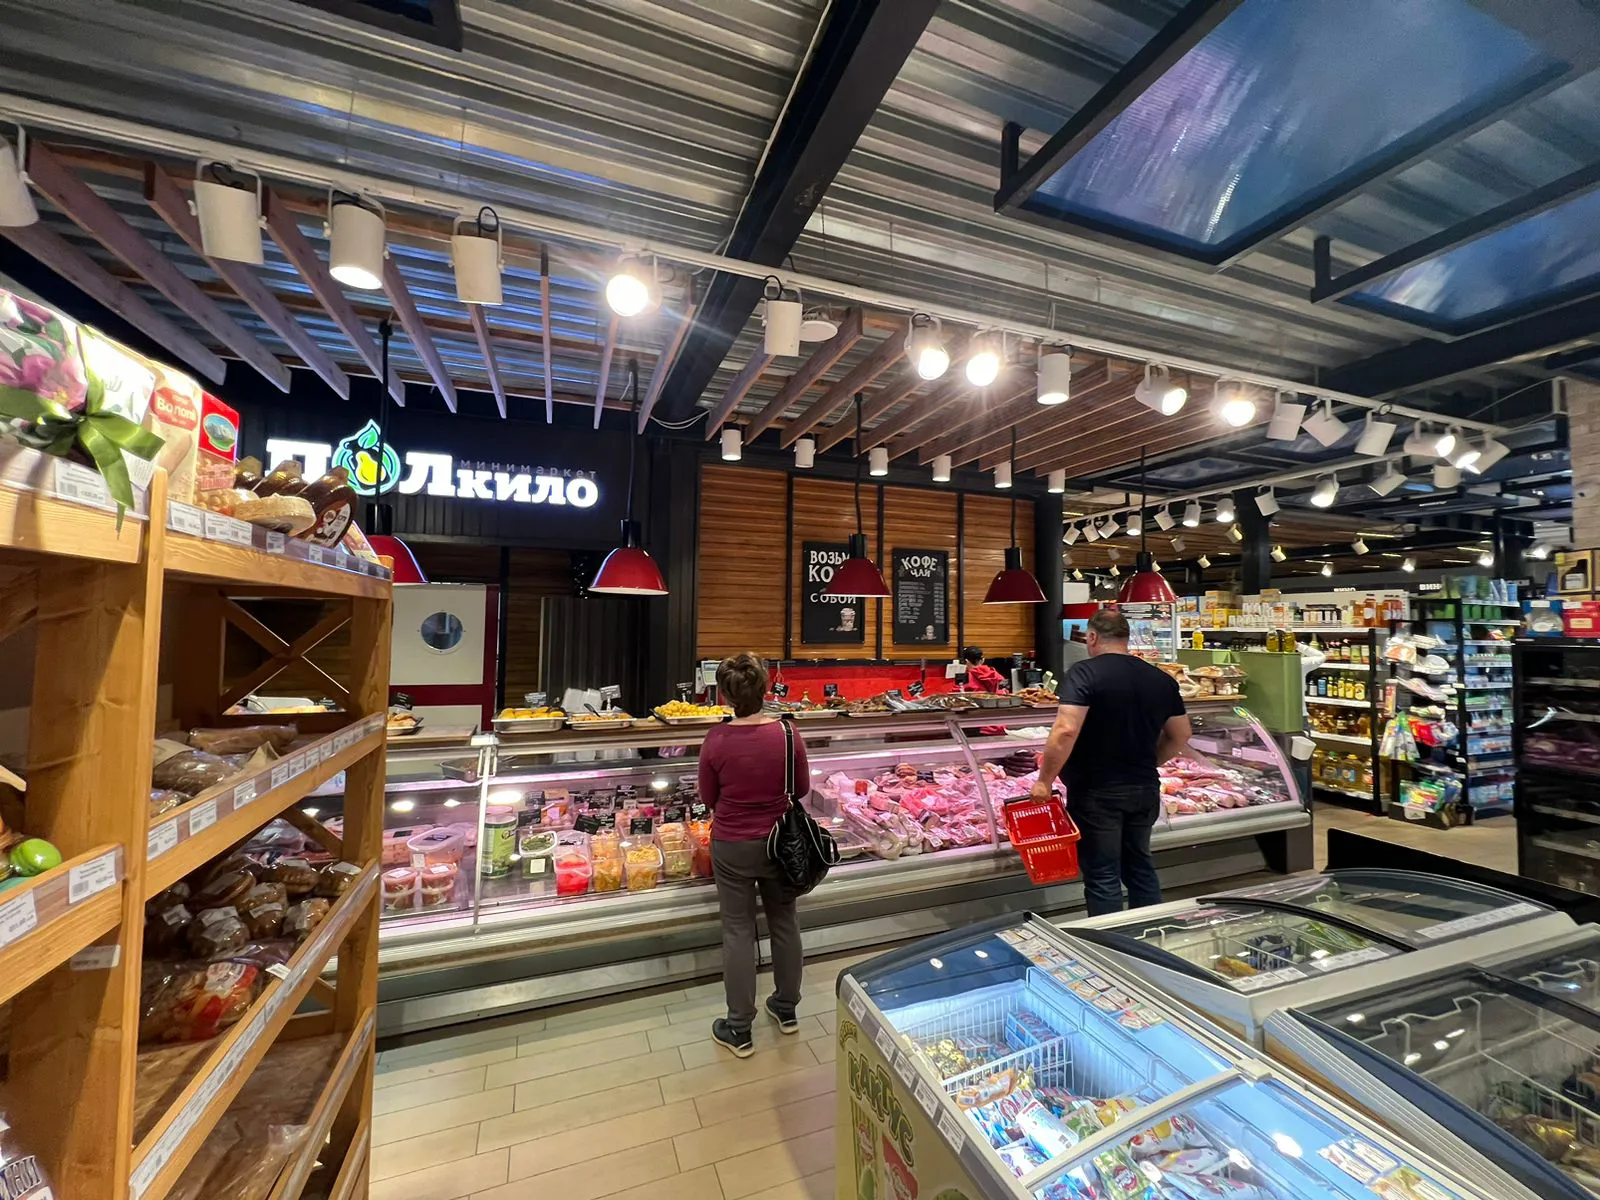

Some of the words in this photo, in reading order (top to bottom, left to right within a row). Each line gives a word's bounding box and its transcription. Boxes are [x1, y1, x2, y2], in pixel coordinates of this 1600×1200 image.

[459, 459, 598, 479] минимаркет
[810, 550, 850, 565] ВОЗЬМ
[901, 555, 938, 571] КОФЕ
[808, 564, 834, 583] КО
